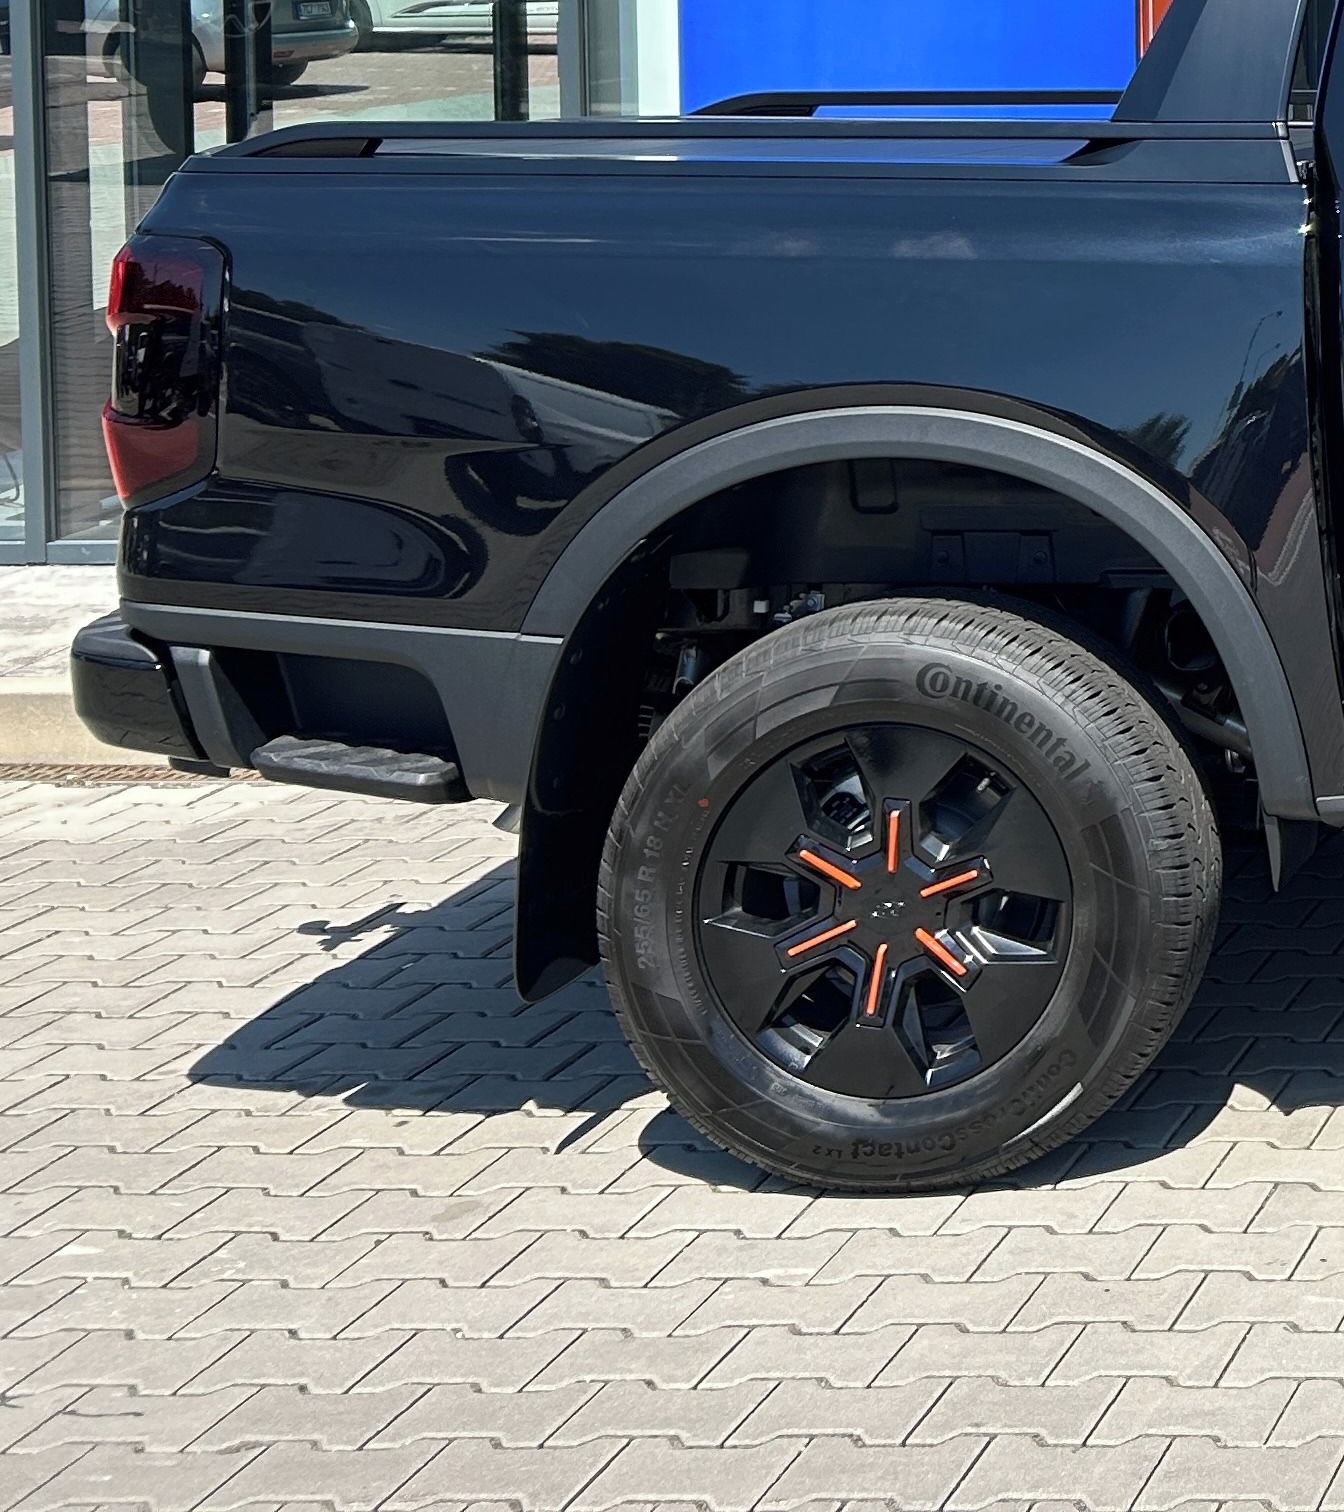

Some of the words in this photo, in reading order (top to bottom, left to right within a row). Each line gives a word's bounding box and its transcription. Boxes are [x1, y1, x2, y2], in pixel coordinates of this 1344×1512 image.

[915, 662, 1092, 780] Continental
[643, 835, 663, 859] 18
[637, 864, 657, 883] R
[633, 888, 657, 969] 255/65
